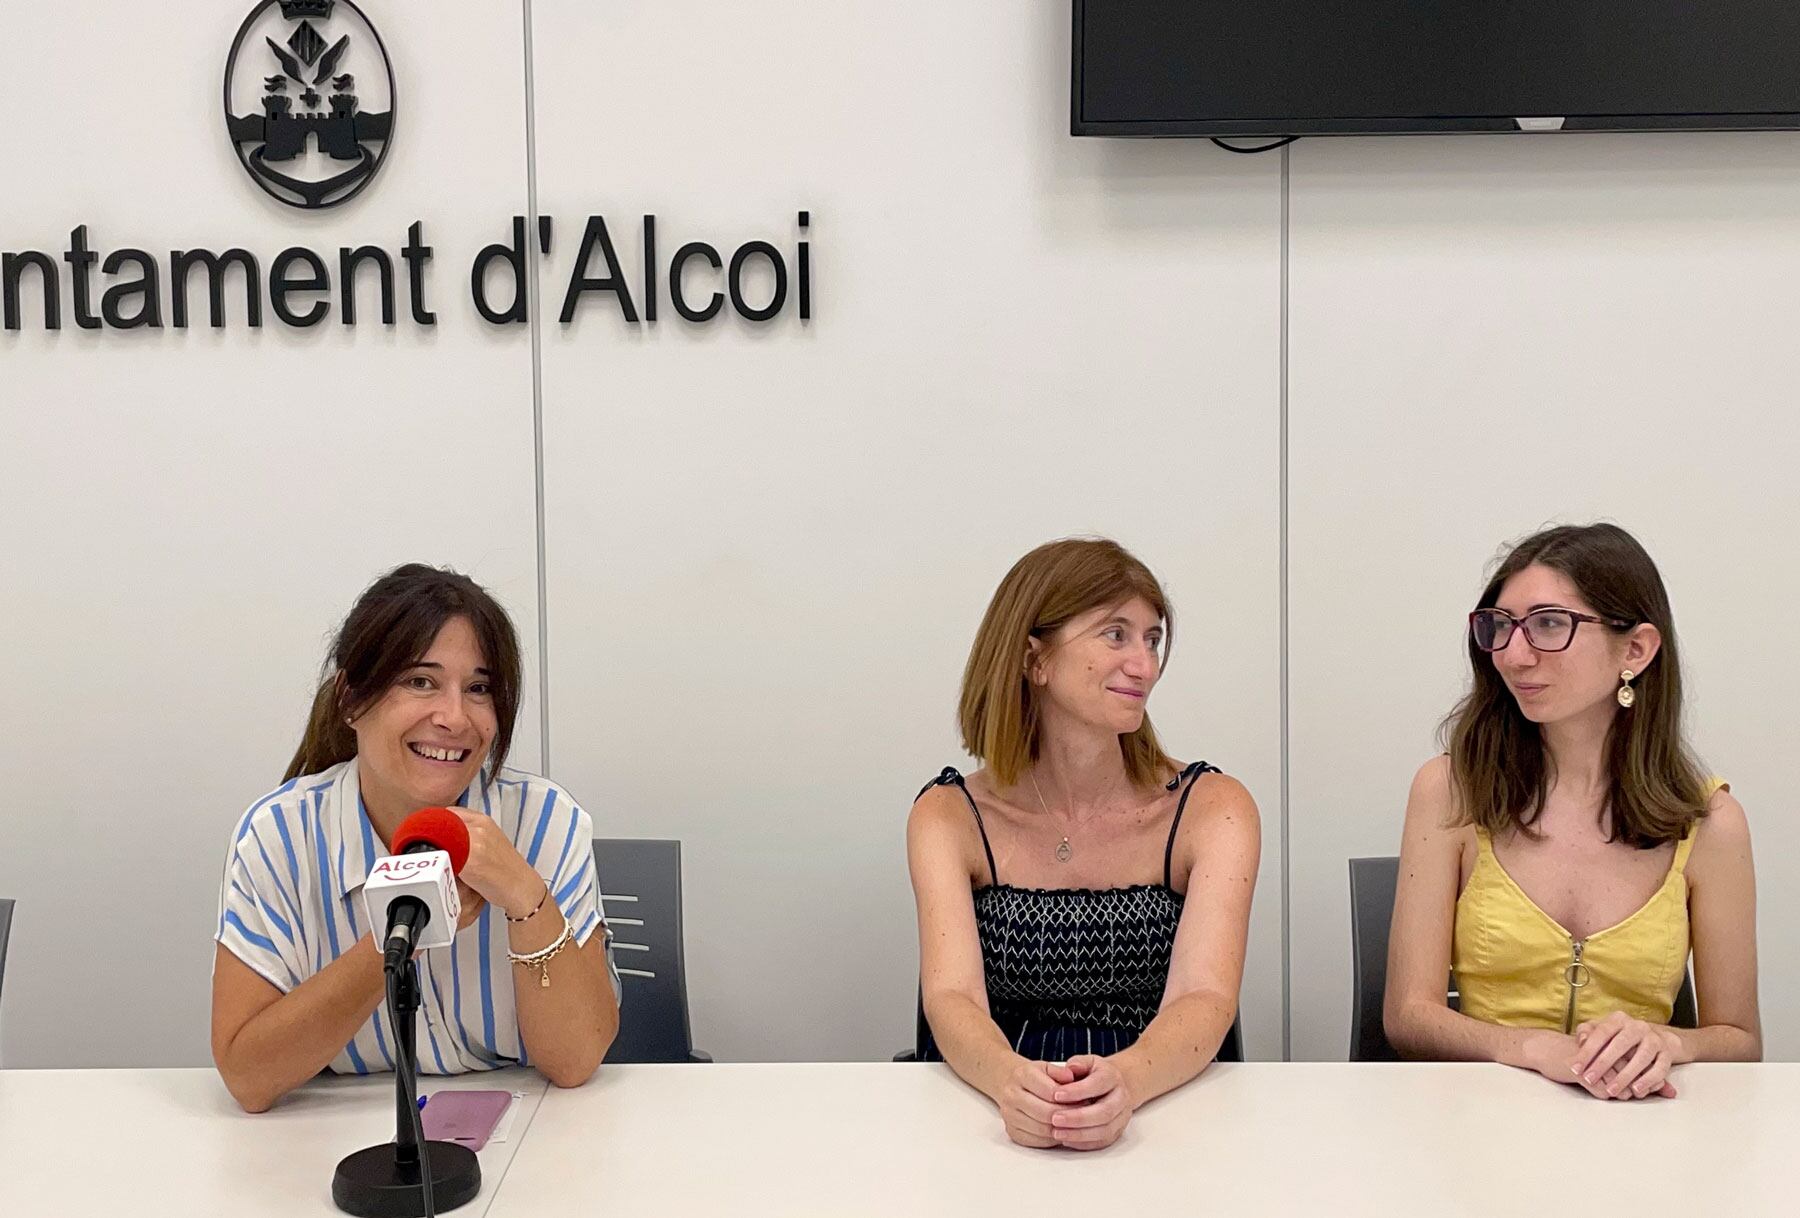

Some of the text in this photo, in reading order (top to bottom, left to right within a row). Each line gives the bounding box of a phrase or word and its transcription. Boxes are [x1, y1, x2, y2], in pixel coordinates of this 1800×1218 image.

[2, 211, 812, 330] ntament d'Alcoi
[373, 856, 439, 874] Alcoi
[443, 866, 458, 919] Alco
